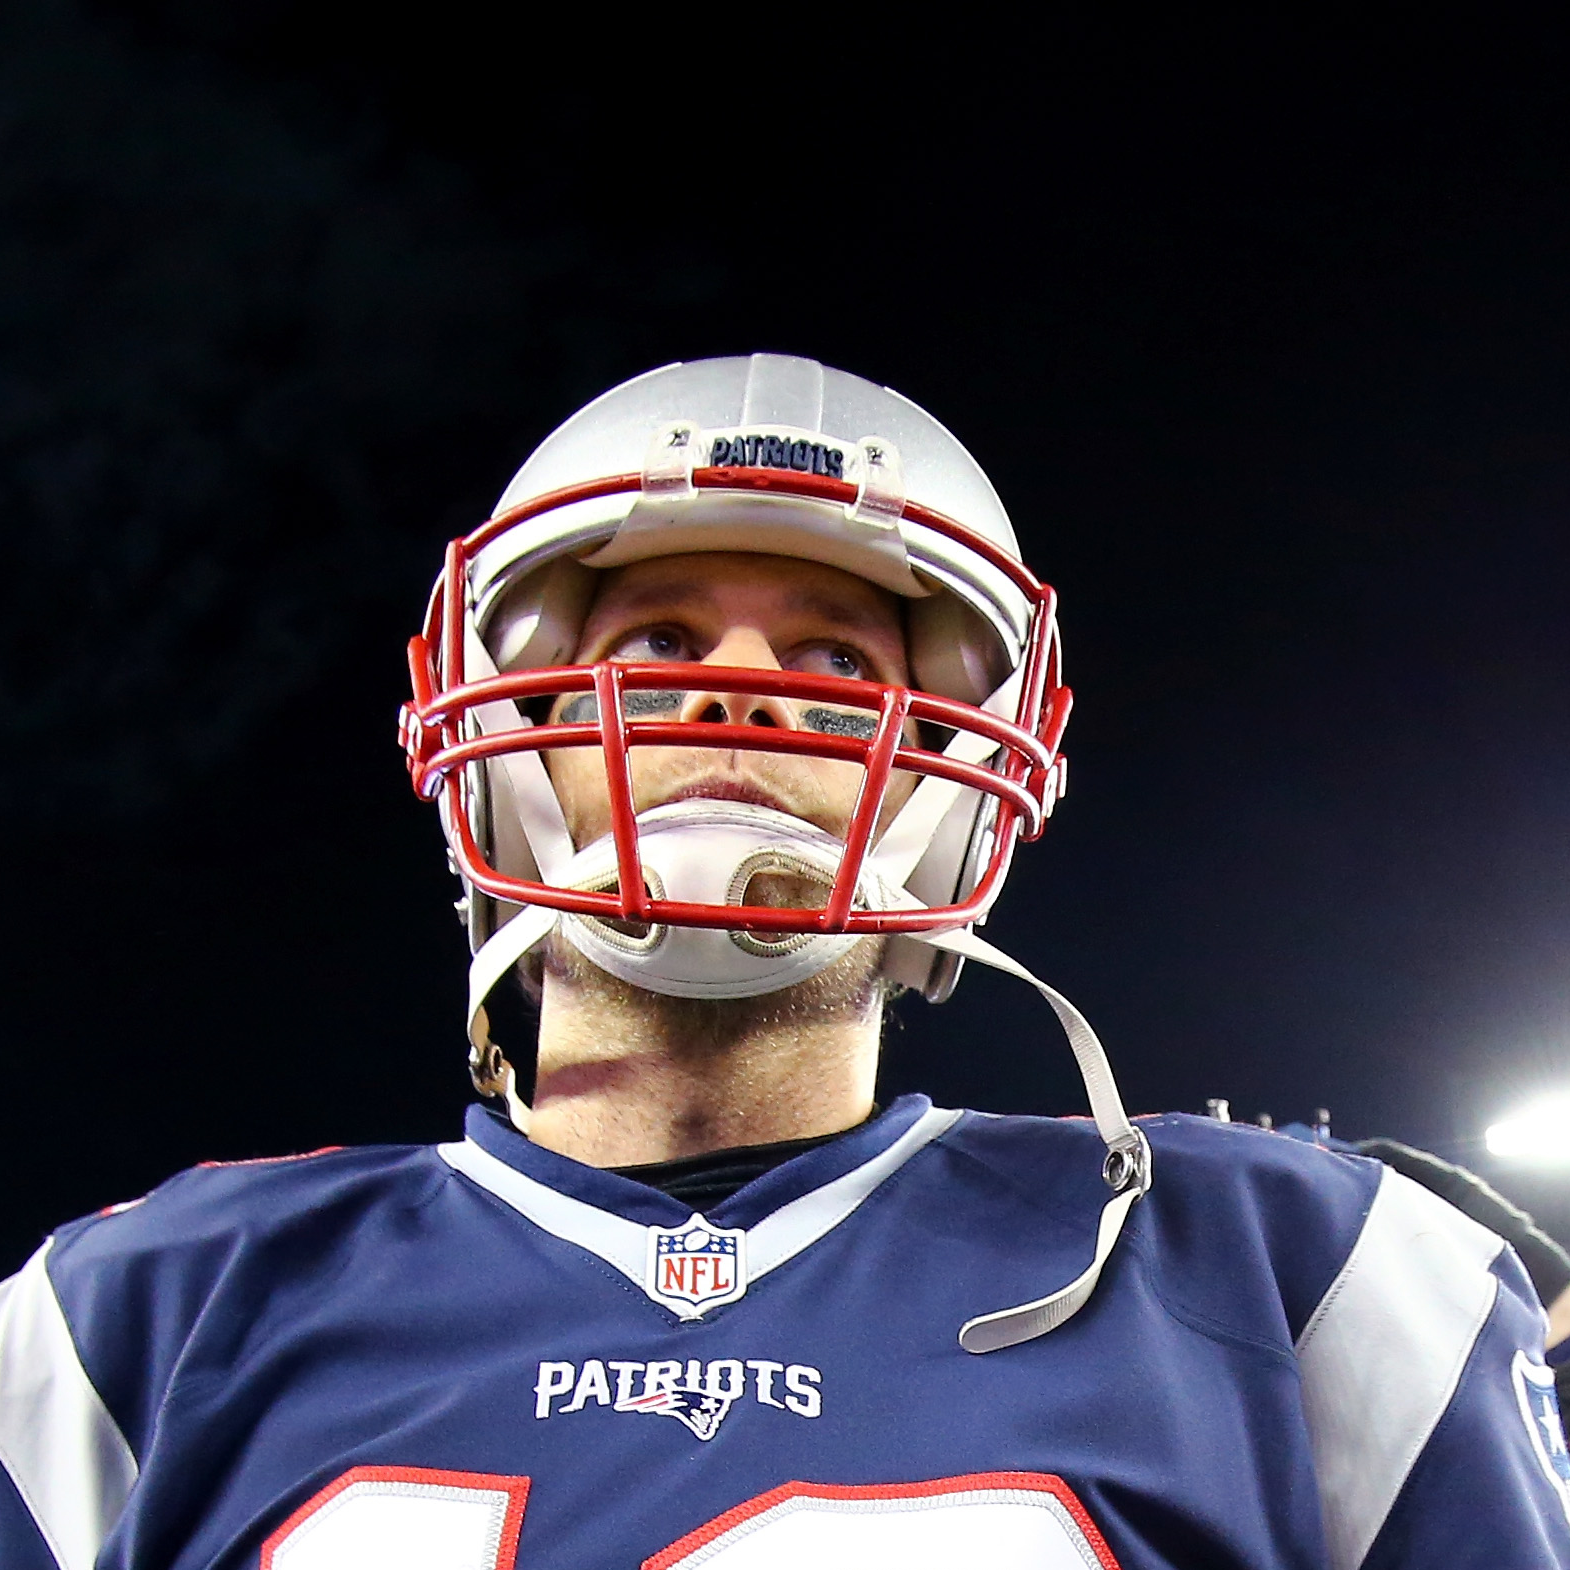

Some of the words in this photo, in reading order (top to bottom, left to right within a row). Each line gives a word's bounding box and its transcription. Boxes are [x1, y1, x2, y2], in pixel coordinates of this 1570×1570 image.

[711, 435, 843, 478] PATRIOTS
[662, 1256, 730, 1296] NFL
[532, 1358, 824, 1419] PATRIOTS
